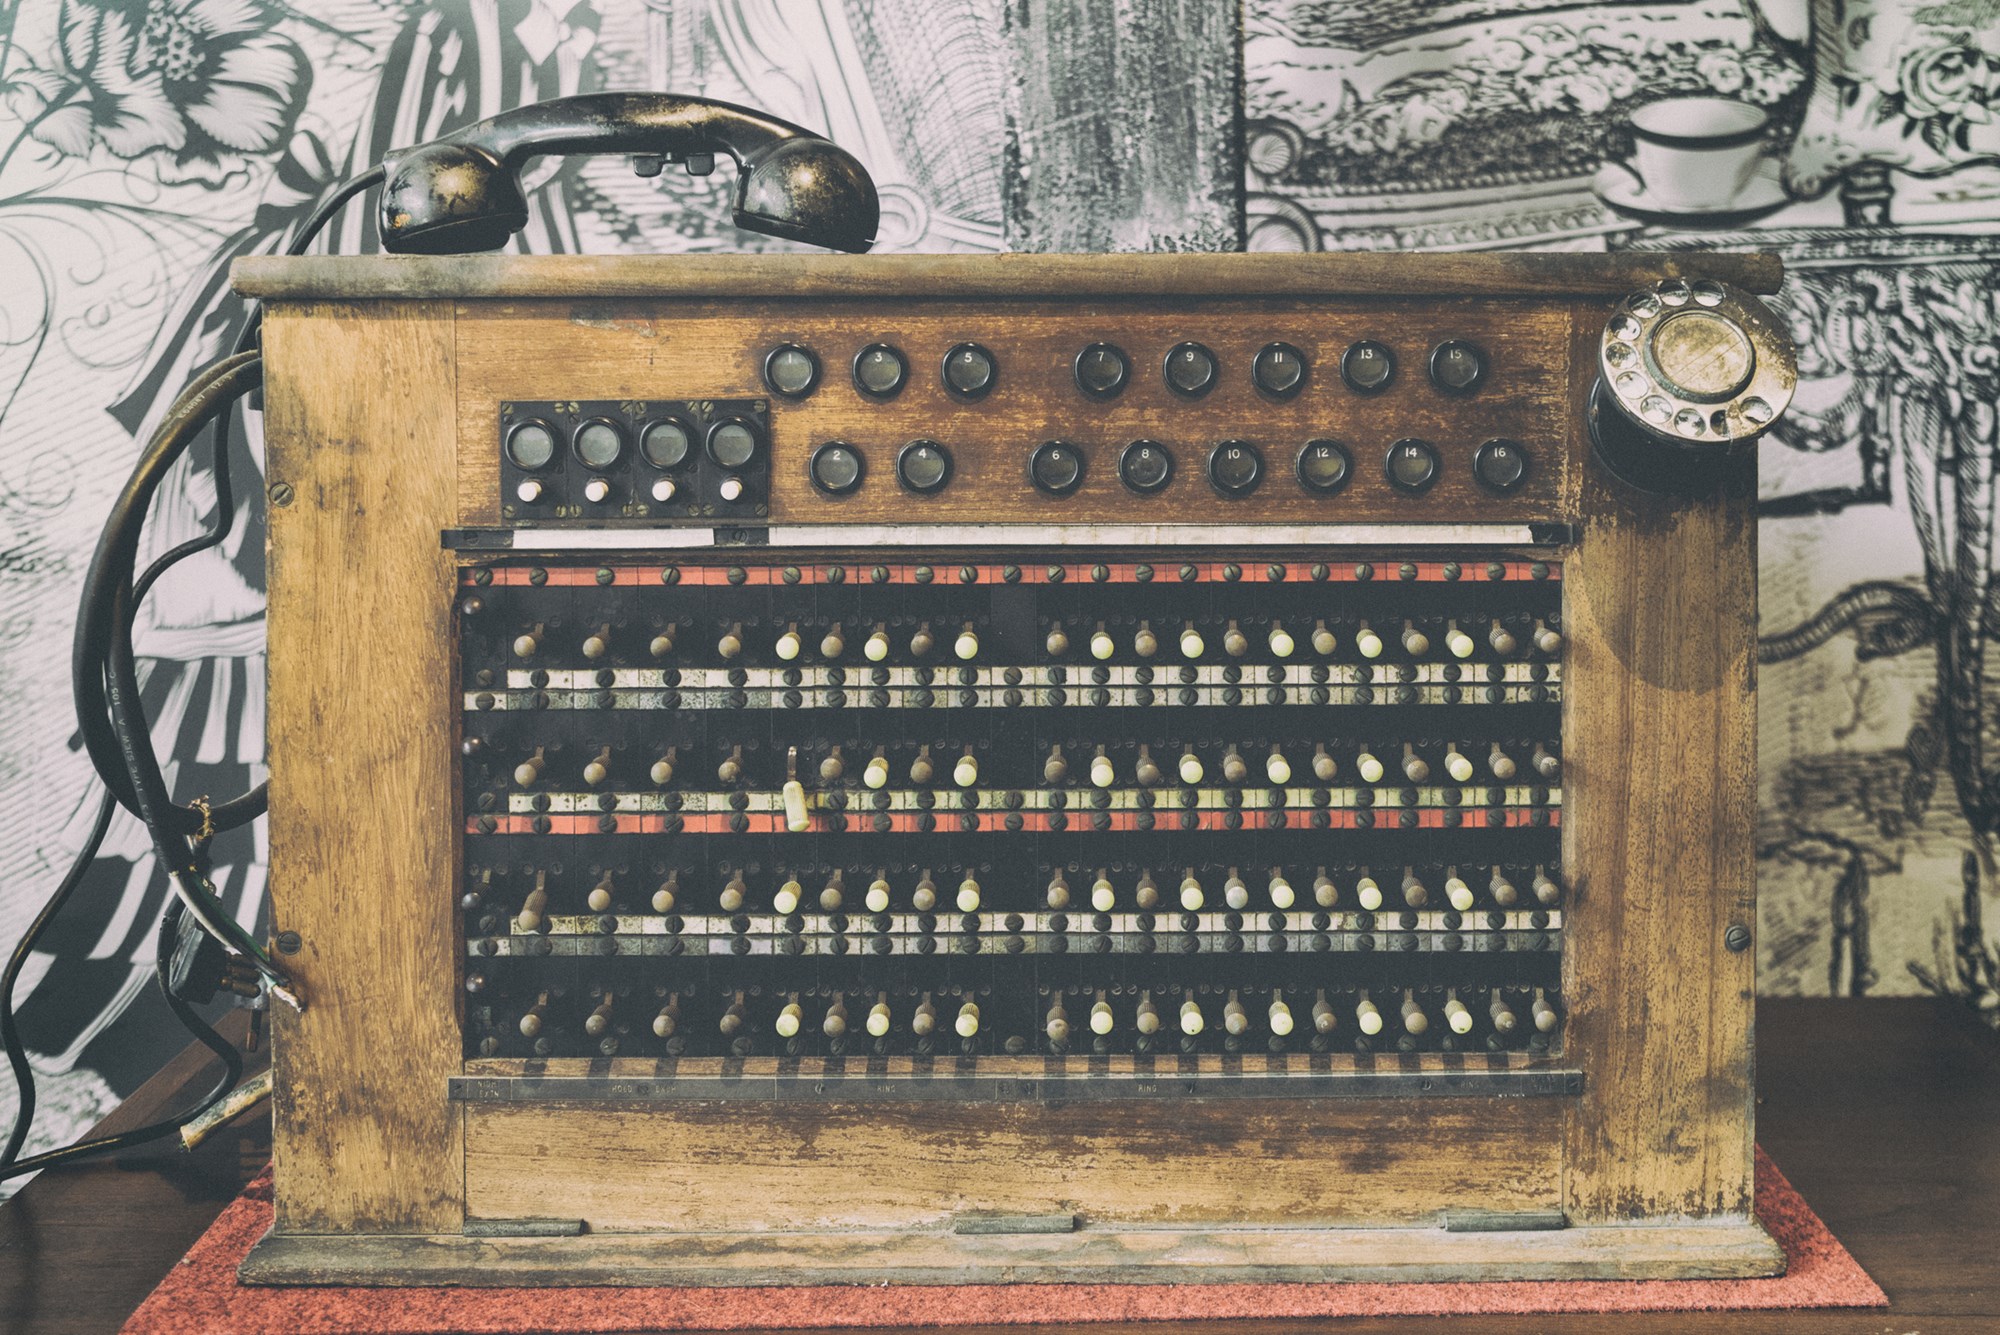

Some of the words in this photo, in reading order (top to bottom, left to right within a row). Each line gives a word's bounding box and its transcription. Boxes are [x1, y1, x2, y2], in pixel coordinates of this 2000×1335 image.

[874, 352, 882, 363] 3
[964, 353, 973, 363] 5
[1097, 352, 1104, 362] 7
[1186, 352, 1194, 362] 9
[1274, 353, 1283, 363] 11
[1361, 350, 1373, 359] 13
[1450, 349, 1461, 360] 15
[832, 450, 841, 460] 2
[918, 449, 927, 459] 4
[1052, 450, 1060, 460] 6
[1141, 449, 1150, 459] 8
[1229, 449, 1241, 460] 10
[1317, 449, 1329, 459] 12
[1406, 448, 1417, 458] 14
[1494, 448, 1506, 458] 16
[612, 1085, 633, 1093] HOLD
[877, 1084, 896, 1093] RING
[1138, 1084, 1157, 1093] RING
